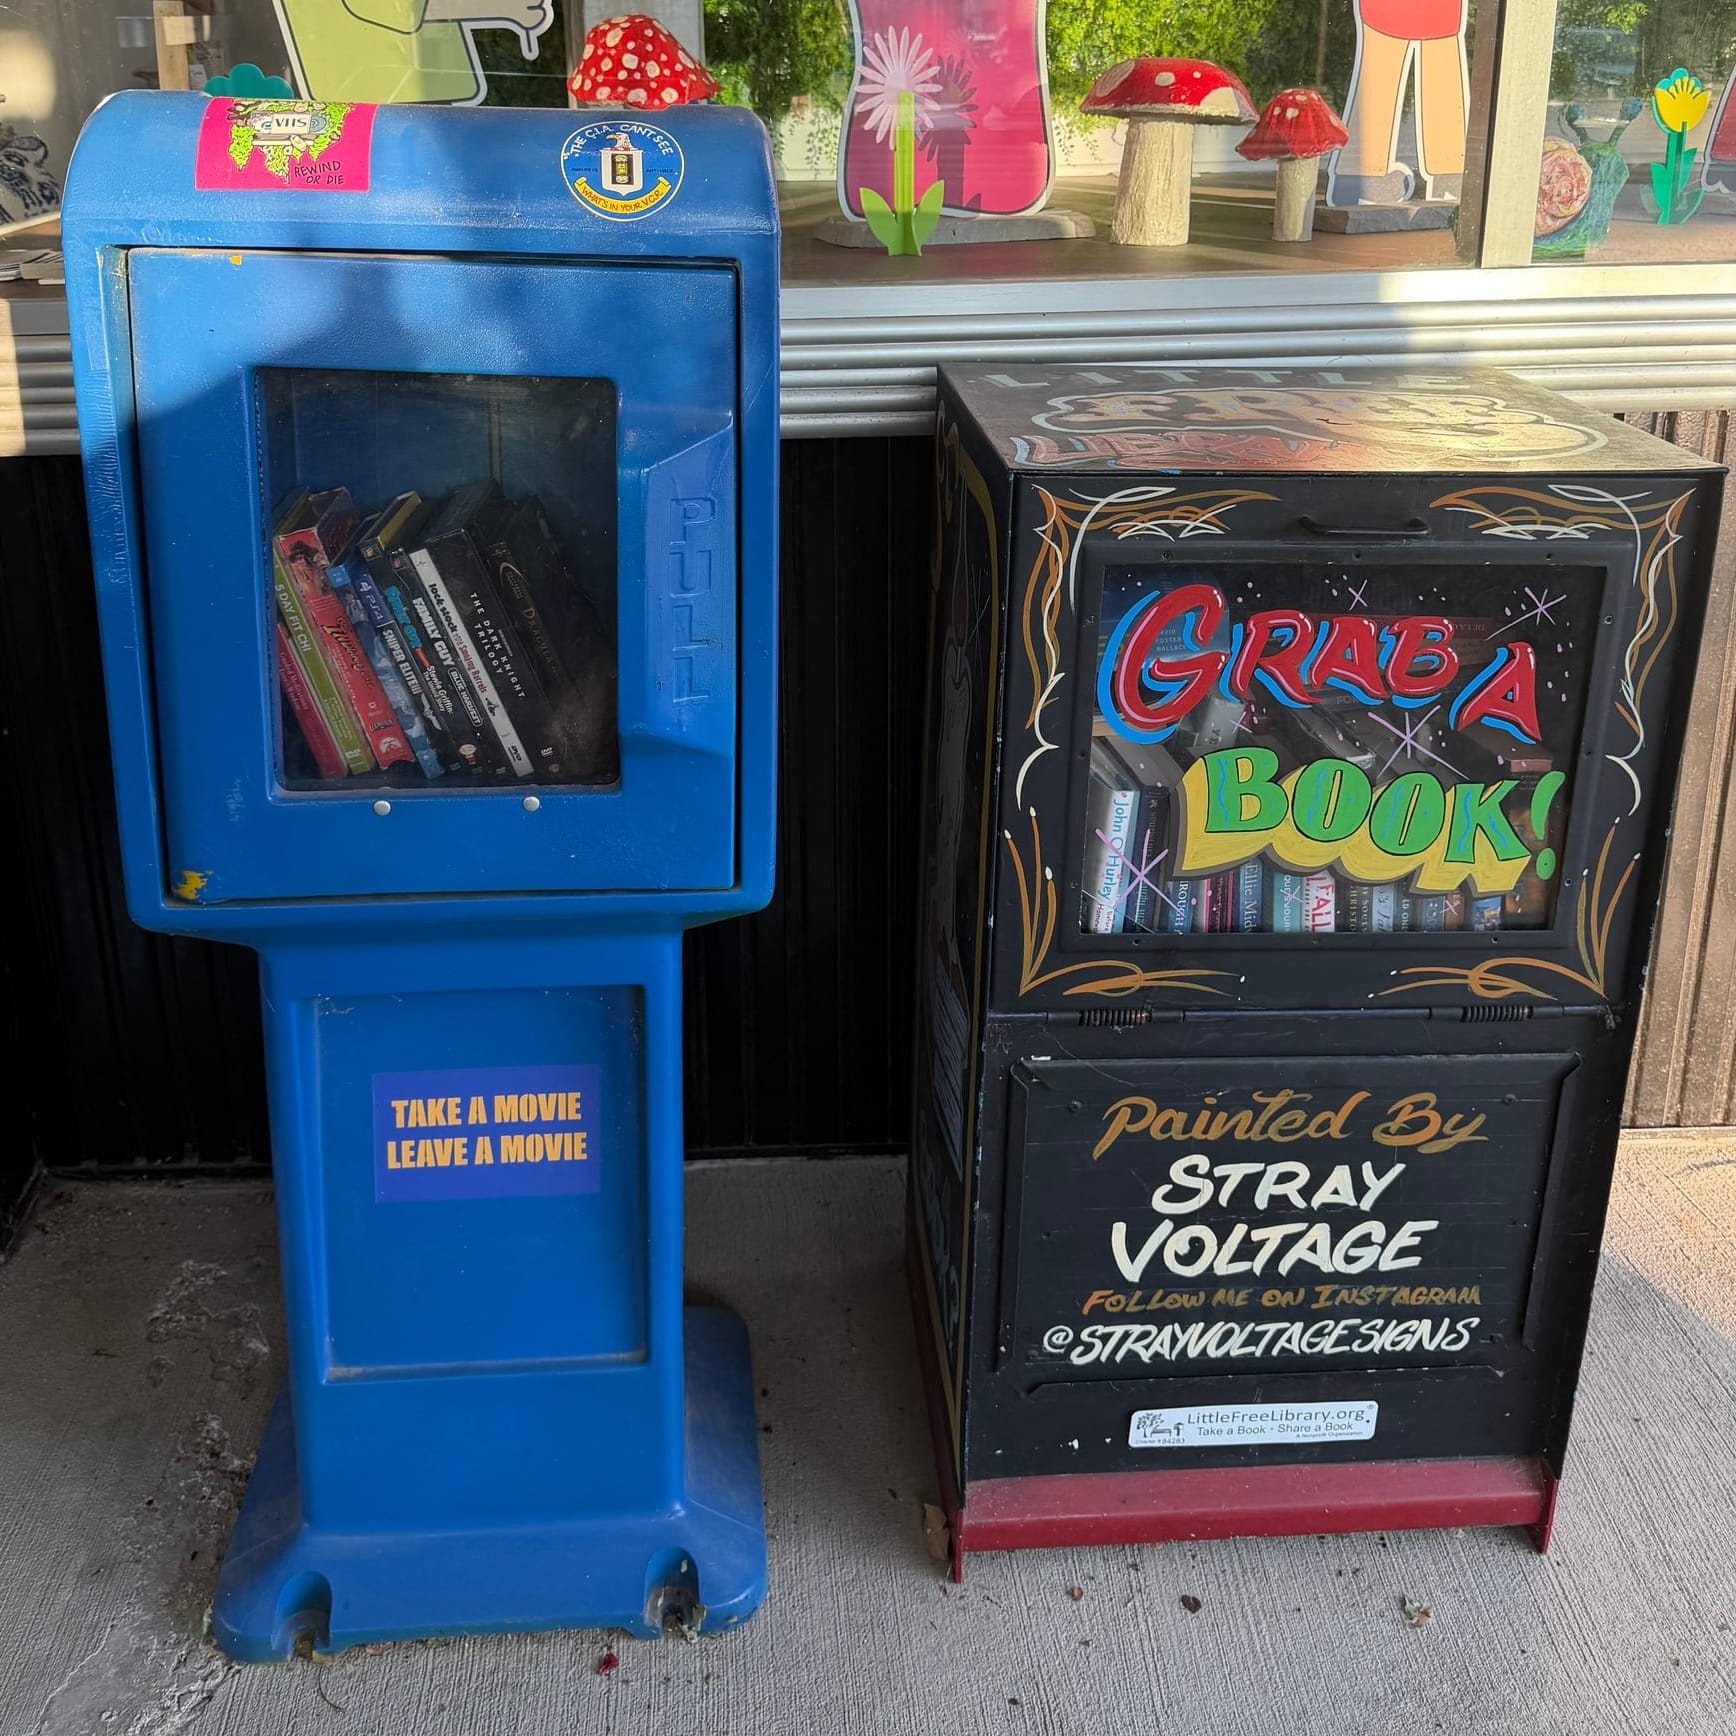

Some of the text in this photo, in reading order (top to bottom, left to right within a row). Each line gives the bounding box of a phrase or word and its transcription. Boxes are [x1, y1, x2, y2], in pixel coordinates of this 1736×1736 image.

[294, 160, 341, 177] REWIND
[653, 135, 674, 156] SEE
[306, 175, 344, 184] OR DIE
[610, 202, 618, 211] IN
[275, 583, 312, 652] 5 DAY FIT CHI
[366, 594, 384, 620] PS4
[412, 597, 455, 667] FAMILY GUY
[428, 583, 445, 607] lock
[440, 604, 459, 634] stock
[382, 629, 407, 662] SNIPER
[470, 592, 484, 615] THE
[483, 619, 502, 650] DARK
[500, 655, 525, 698] KNIGHT
[474, 623, 503, 674] TRILOGY
[1098, 584, 1542, 744] GRAB A
[451, 670, 481, 725] BLUE HARVEST
[1113, 799, 1130, 833] John
[1183, 745, 1566, 889] BOOK!
[1244, 863, 1258, 897] Ellie
[1091, 1089, 1489, 1160] Painted By
[1151, 1154, 1406, 1216] STRAY
[1111, 1219, 1439, 1283] VOLTAGE
[1081, 1284, 1482, 1316] FOLLOW ME ON INSTAGRAM
[1042, 1316, 1480, 1366] @STRAYVOLTAGESIGNS
[1187, 1409, 1365, 1425] LittleFreeLibrary.org
[1197, 1421, 1353, 1436] Take a Book Share a Book
